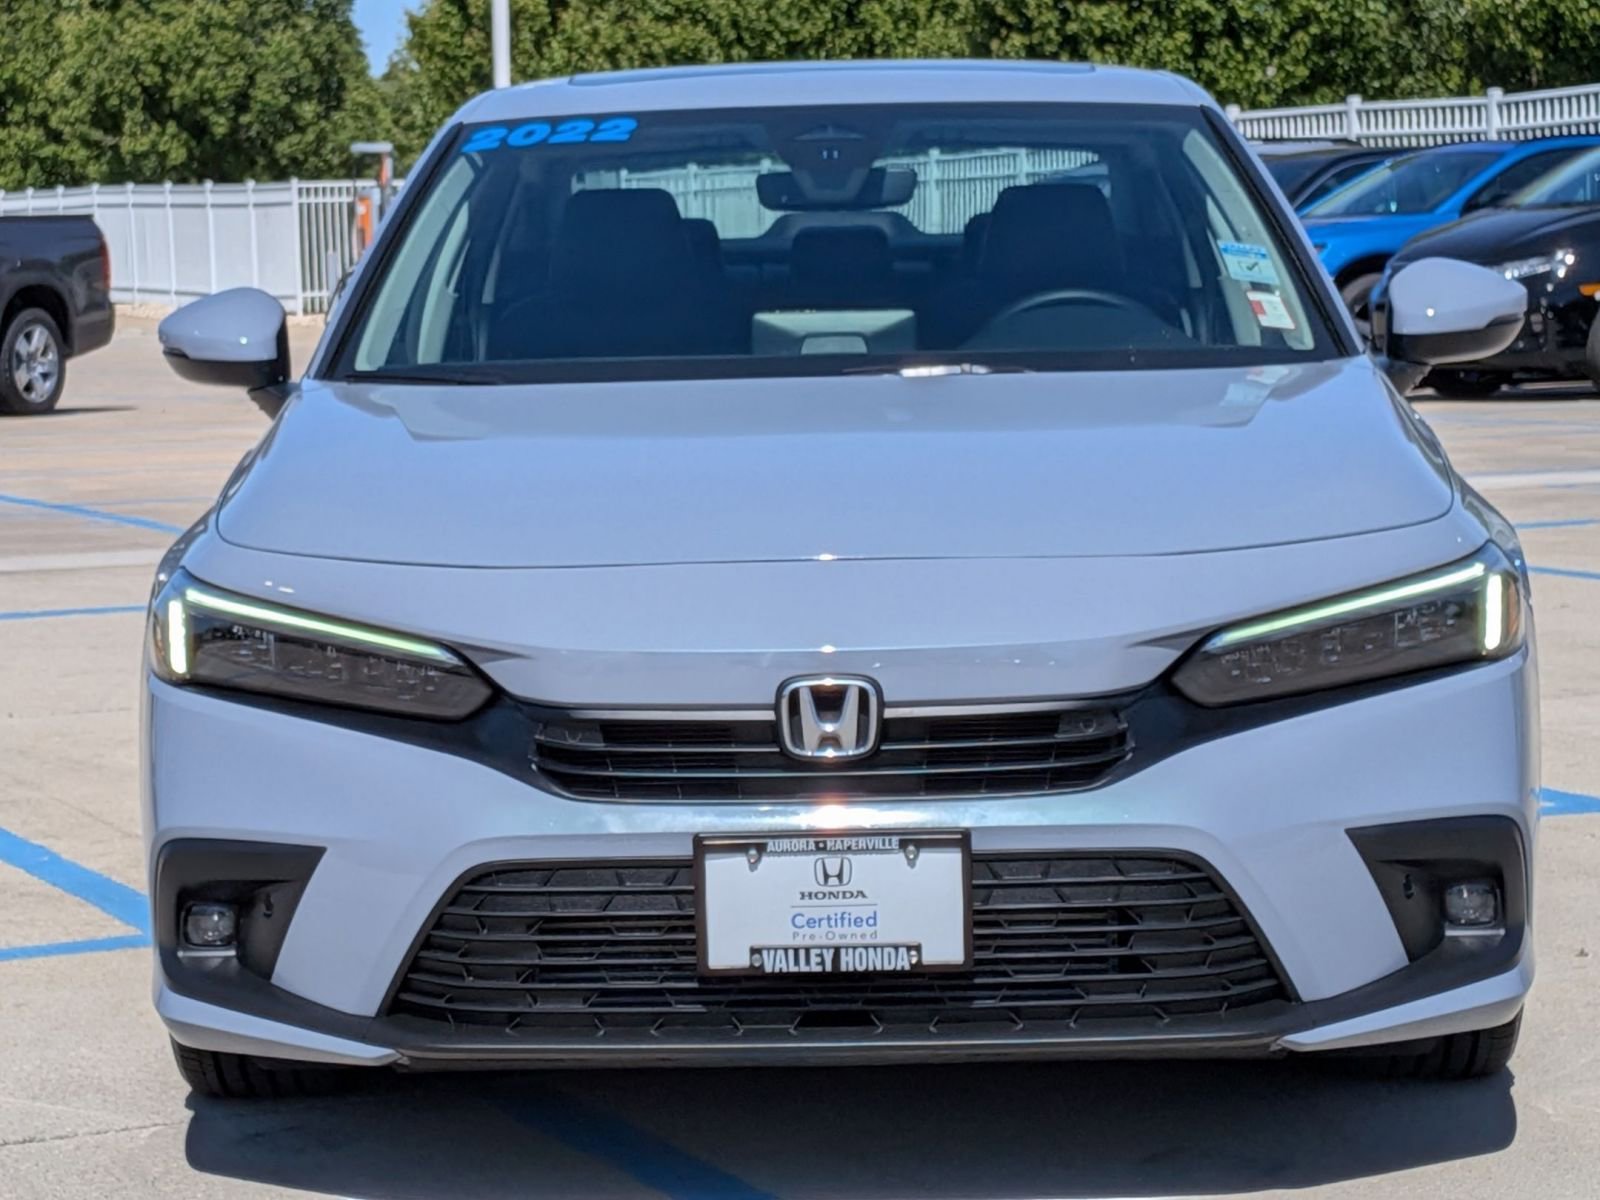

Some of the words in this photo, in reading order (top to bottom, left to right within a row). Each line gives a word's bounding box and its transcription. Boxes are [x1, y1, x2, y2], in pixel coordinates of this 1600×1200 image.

[461, 117, 637, 153] 2022
[767, 839, 816, 852] AURORA
[799, 890, 868, 900] HONDA
[791, 911, 878, 929] Certified
[793, 930, 878, 941] Pre-Owned
[763, 949, 834, 973] VALLEY
[840, 947, 910, 972] HONDA
